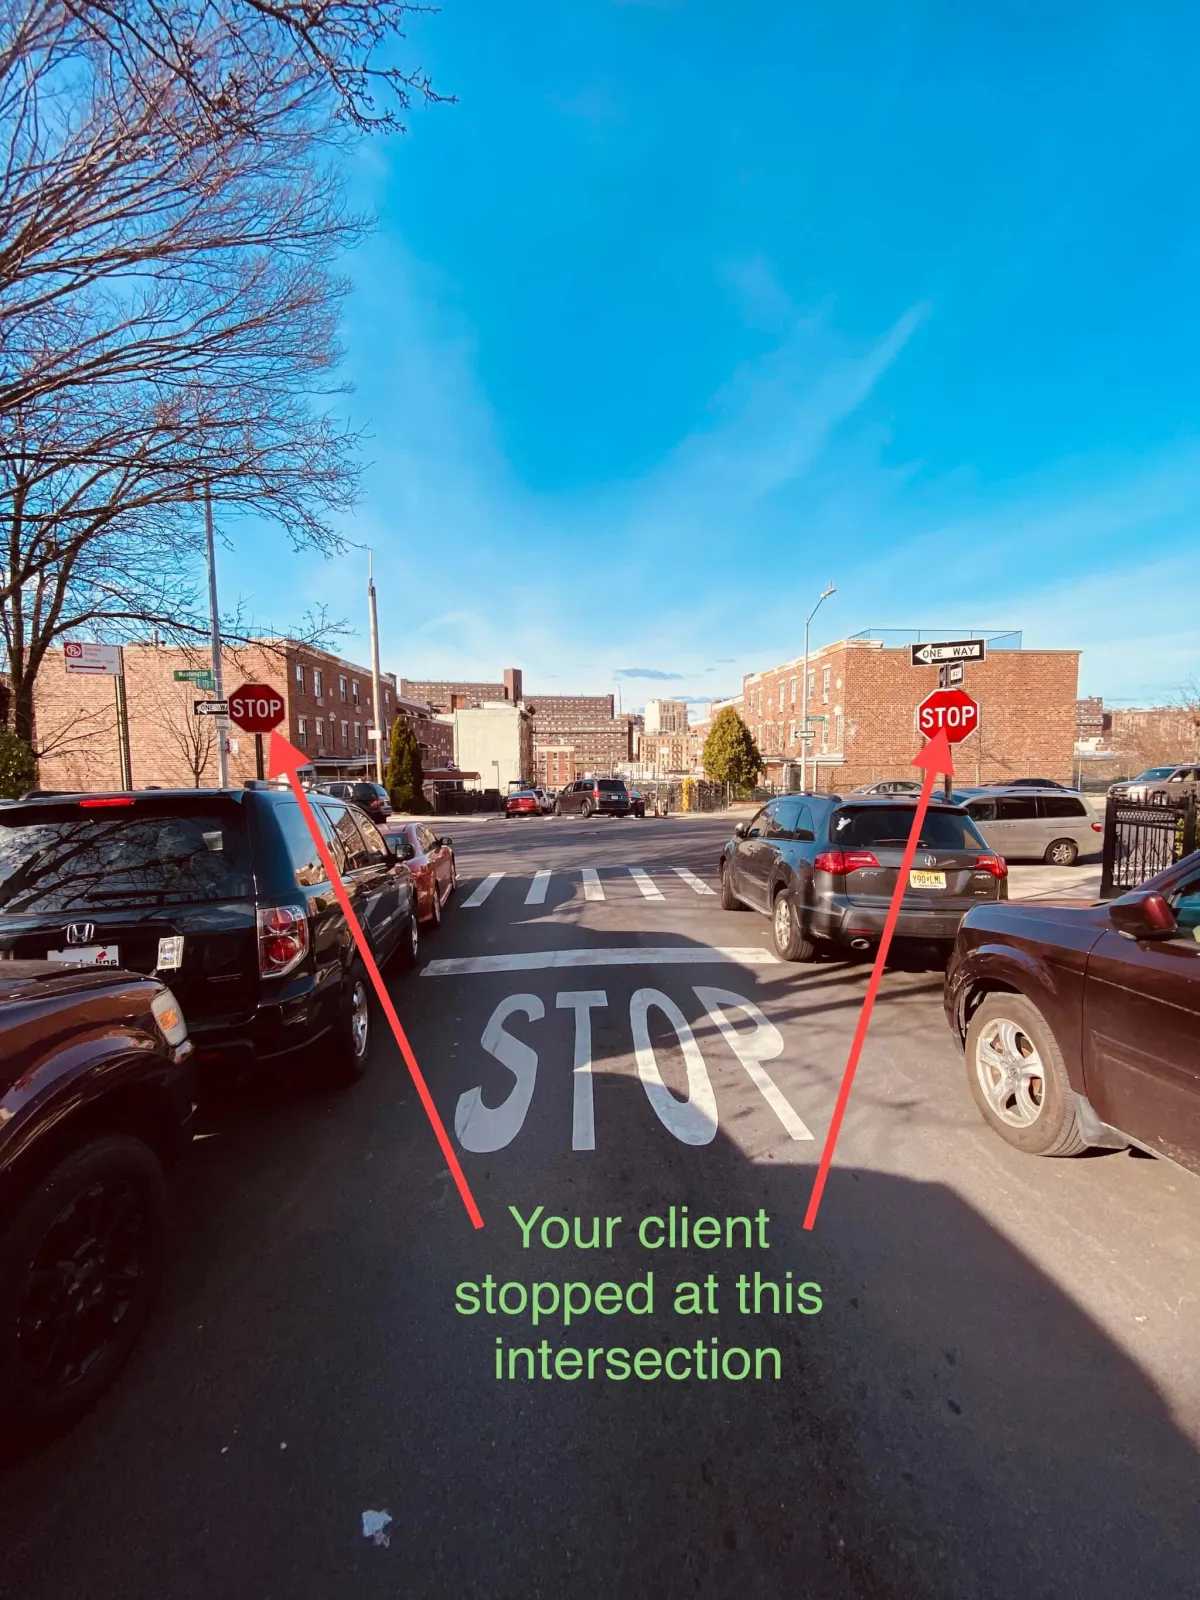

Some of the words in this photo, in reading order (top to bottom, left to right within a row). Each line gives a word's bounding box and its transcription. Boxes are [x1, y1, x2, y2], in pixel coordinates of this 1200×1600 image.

[922, 649, 943, 659] ONE
[953, 646, 975, 656] WAY
[232, 699, 282, 718] STOP
[921, 705, 975, 728] STOP
[454, 986, 815, 1153] STOP
